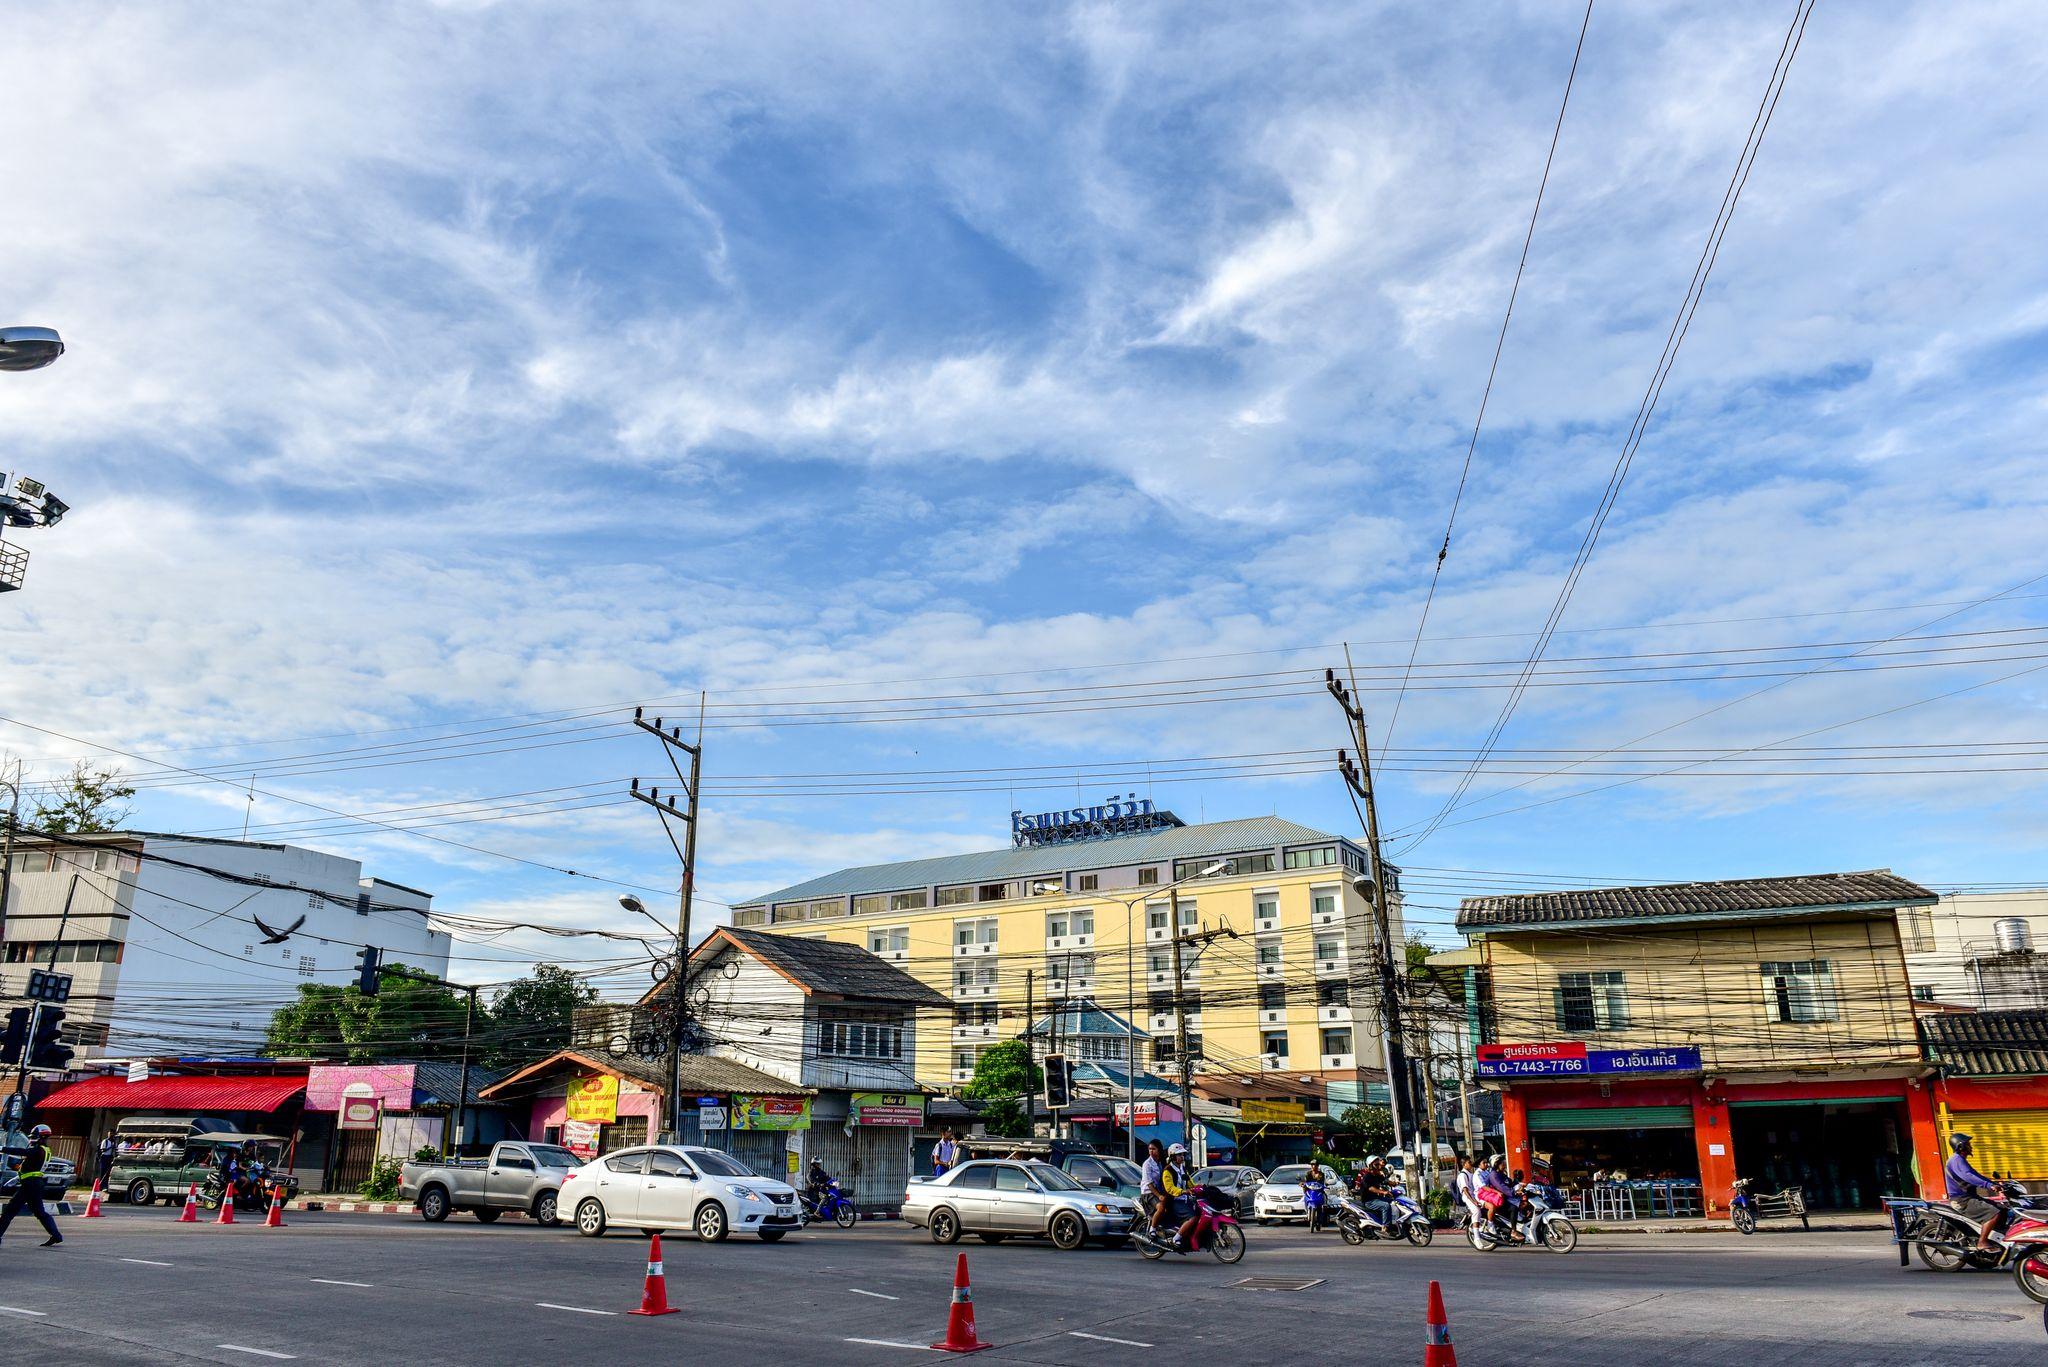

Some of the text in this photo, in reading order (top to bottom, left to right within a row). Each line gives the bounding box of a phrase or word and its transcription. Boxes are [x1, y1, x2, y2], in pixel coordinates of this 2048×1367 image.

[1503, 1044, 1558, 1059] ศูนย์บริการ
[1480, 1059, 1582, 1074] โทร. 0-7443-7766
[1613, 1052, 1677, 1067] เอ.เอ็น.แก๊ส
